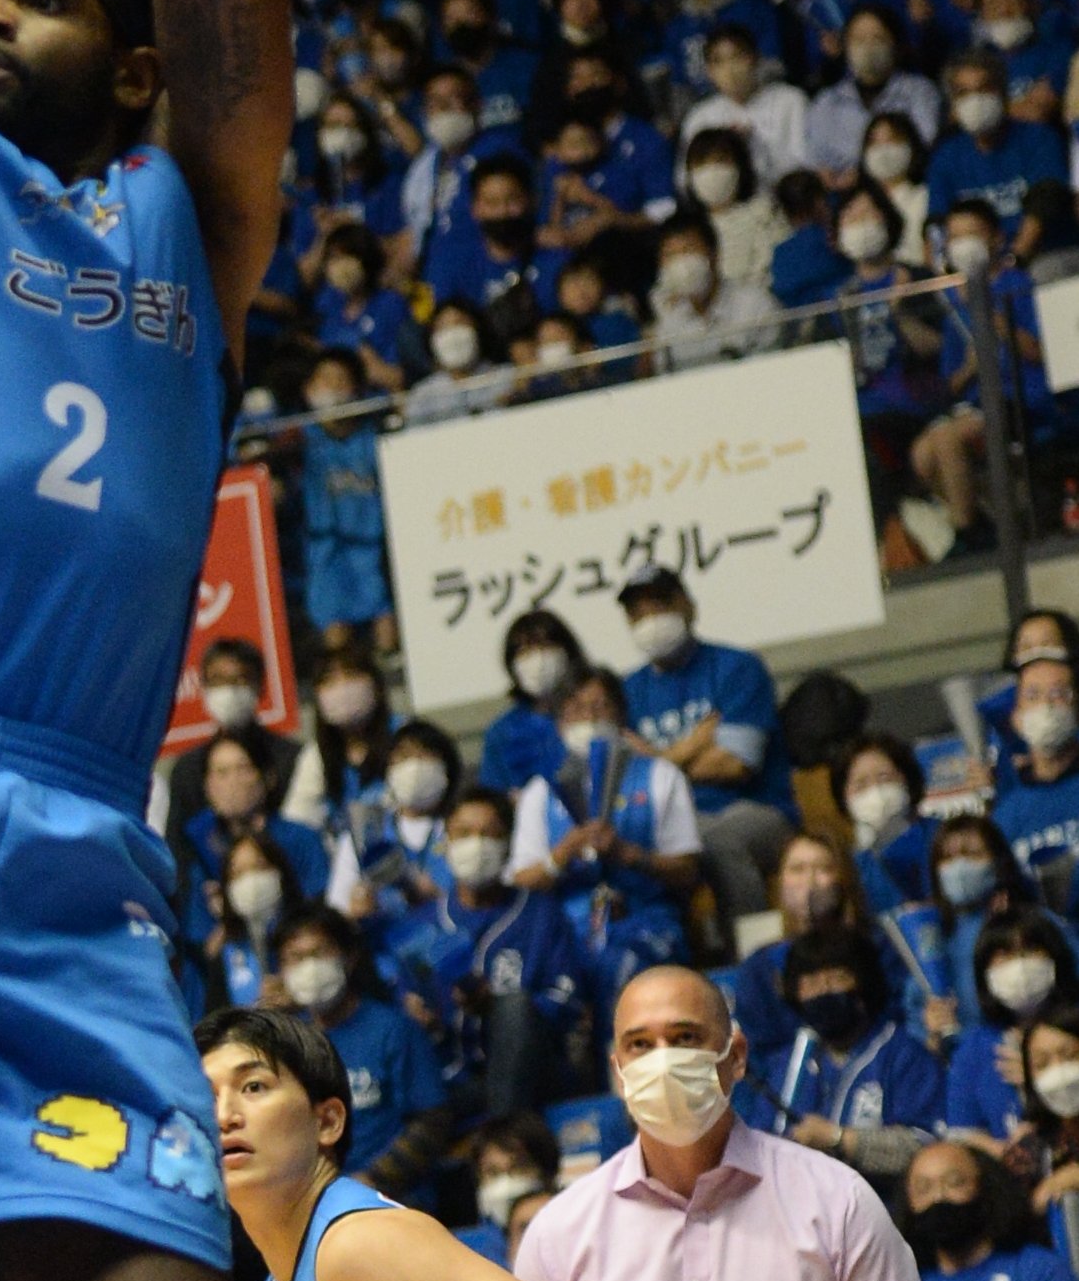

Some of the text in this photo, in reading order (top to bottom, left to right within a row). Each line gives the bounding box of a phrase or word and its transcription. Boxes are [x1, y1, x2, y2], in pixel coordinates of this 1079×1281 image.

[5, 248, 197, 357] ごうぎん
[35, 381, 108, 513] 2
[431, 487, 832, 627] ラッシュグループ
